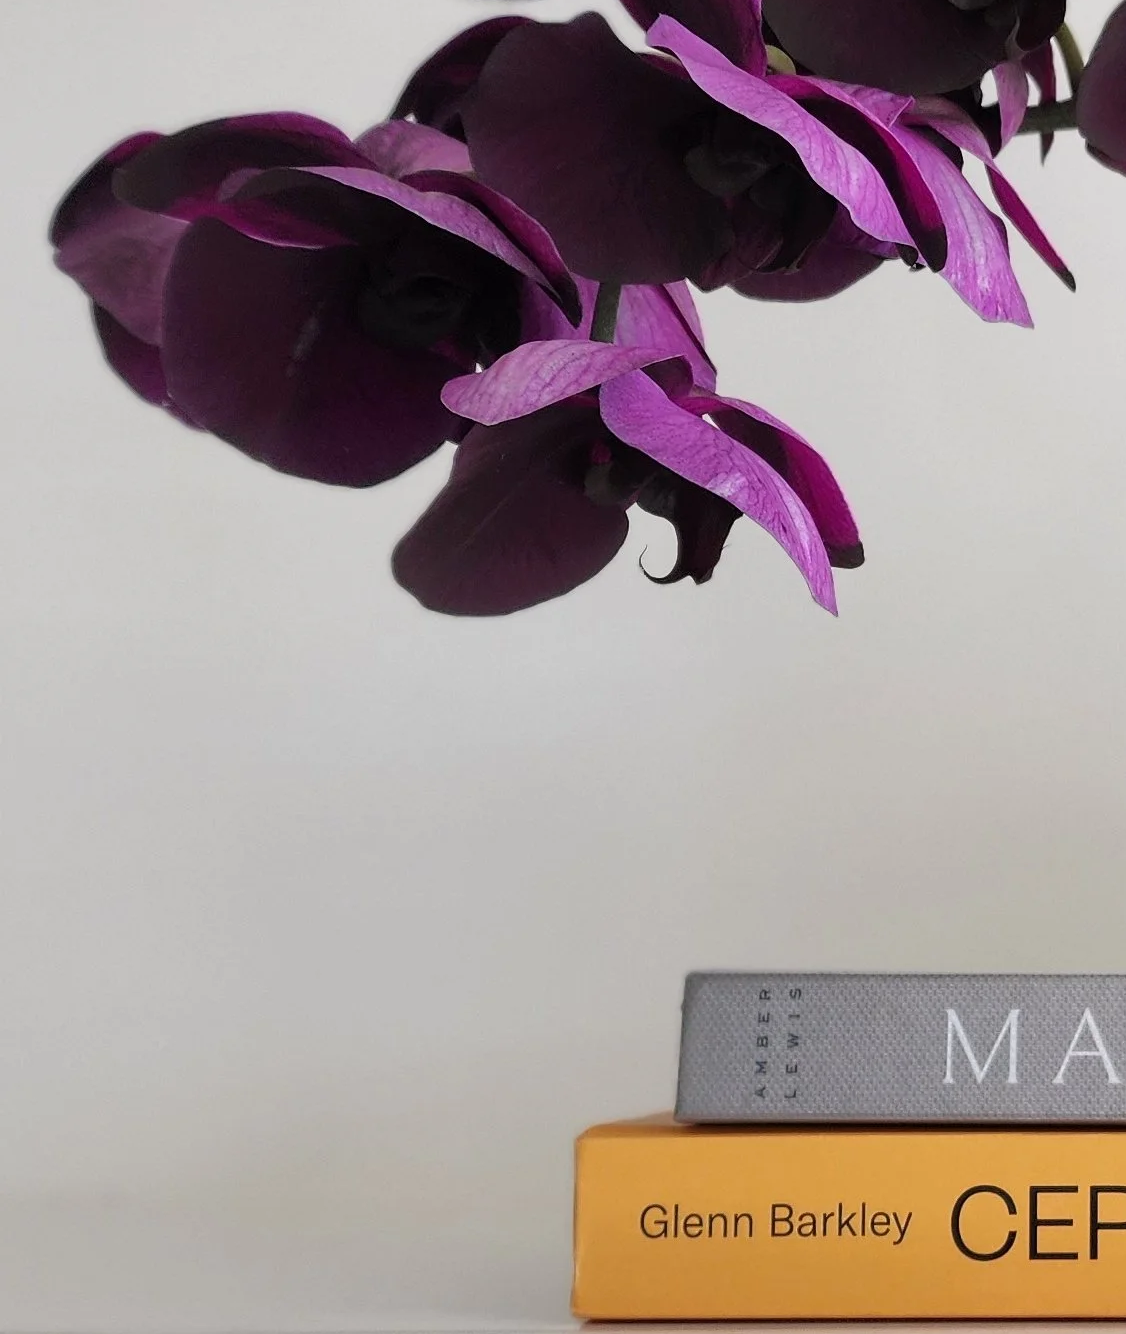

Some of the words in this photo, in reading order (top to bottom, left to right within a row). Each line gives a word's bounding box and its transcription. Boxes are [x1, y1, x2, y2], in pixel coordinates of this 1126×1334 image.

[755, 988, 771, 1099] AMBER
[784, 988, 802, 1099] LEWIS
[639, 1203, 754, 1240] Glenn
[769, 1203, 914, 1246] Barkley
